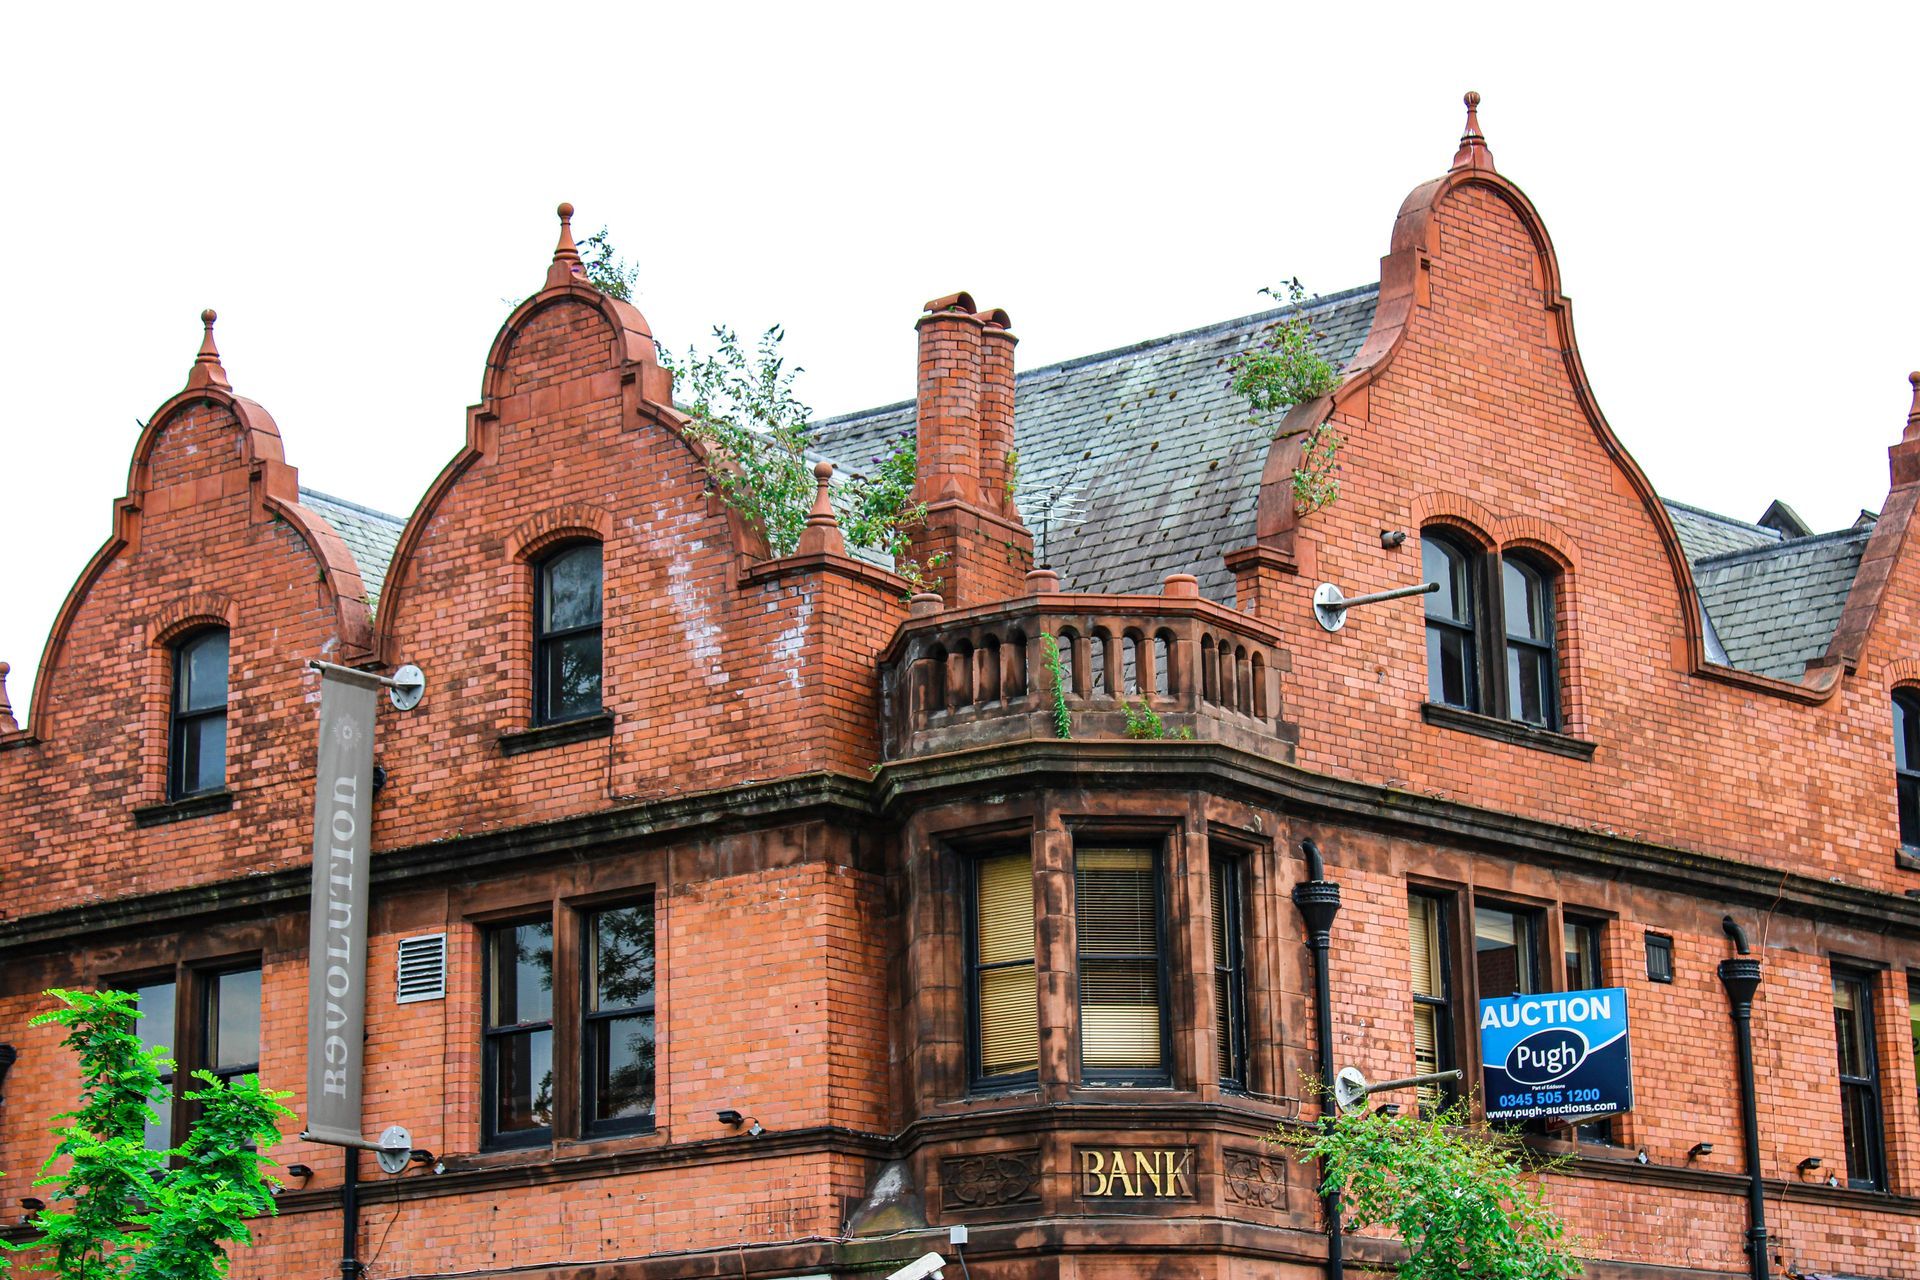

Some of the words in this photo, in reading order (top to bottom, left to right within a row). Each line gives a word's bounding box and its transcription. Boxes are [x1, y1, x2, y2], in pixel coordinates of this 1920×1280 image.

[1480, 996, 1611, 1029] AUCTION
[1517, 1041, 1576, 1073] Pugh
[1486, 1102, 1617, 1119] www.pugh-auctions.com
[1499, 1093, 1533, 1108] 0345
[1536, 1091, 1563, 1105] 505
[1566, 1087, 1600, 1102] 1200
[1080, 1151, 1192, 1196] BANK
